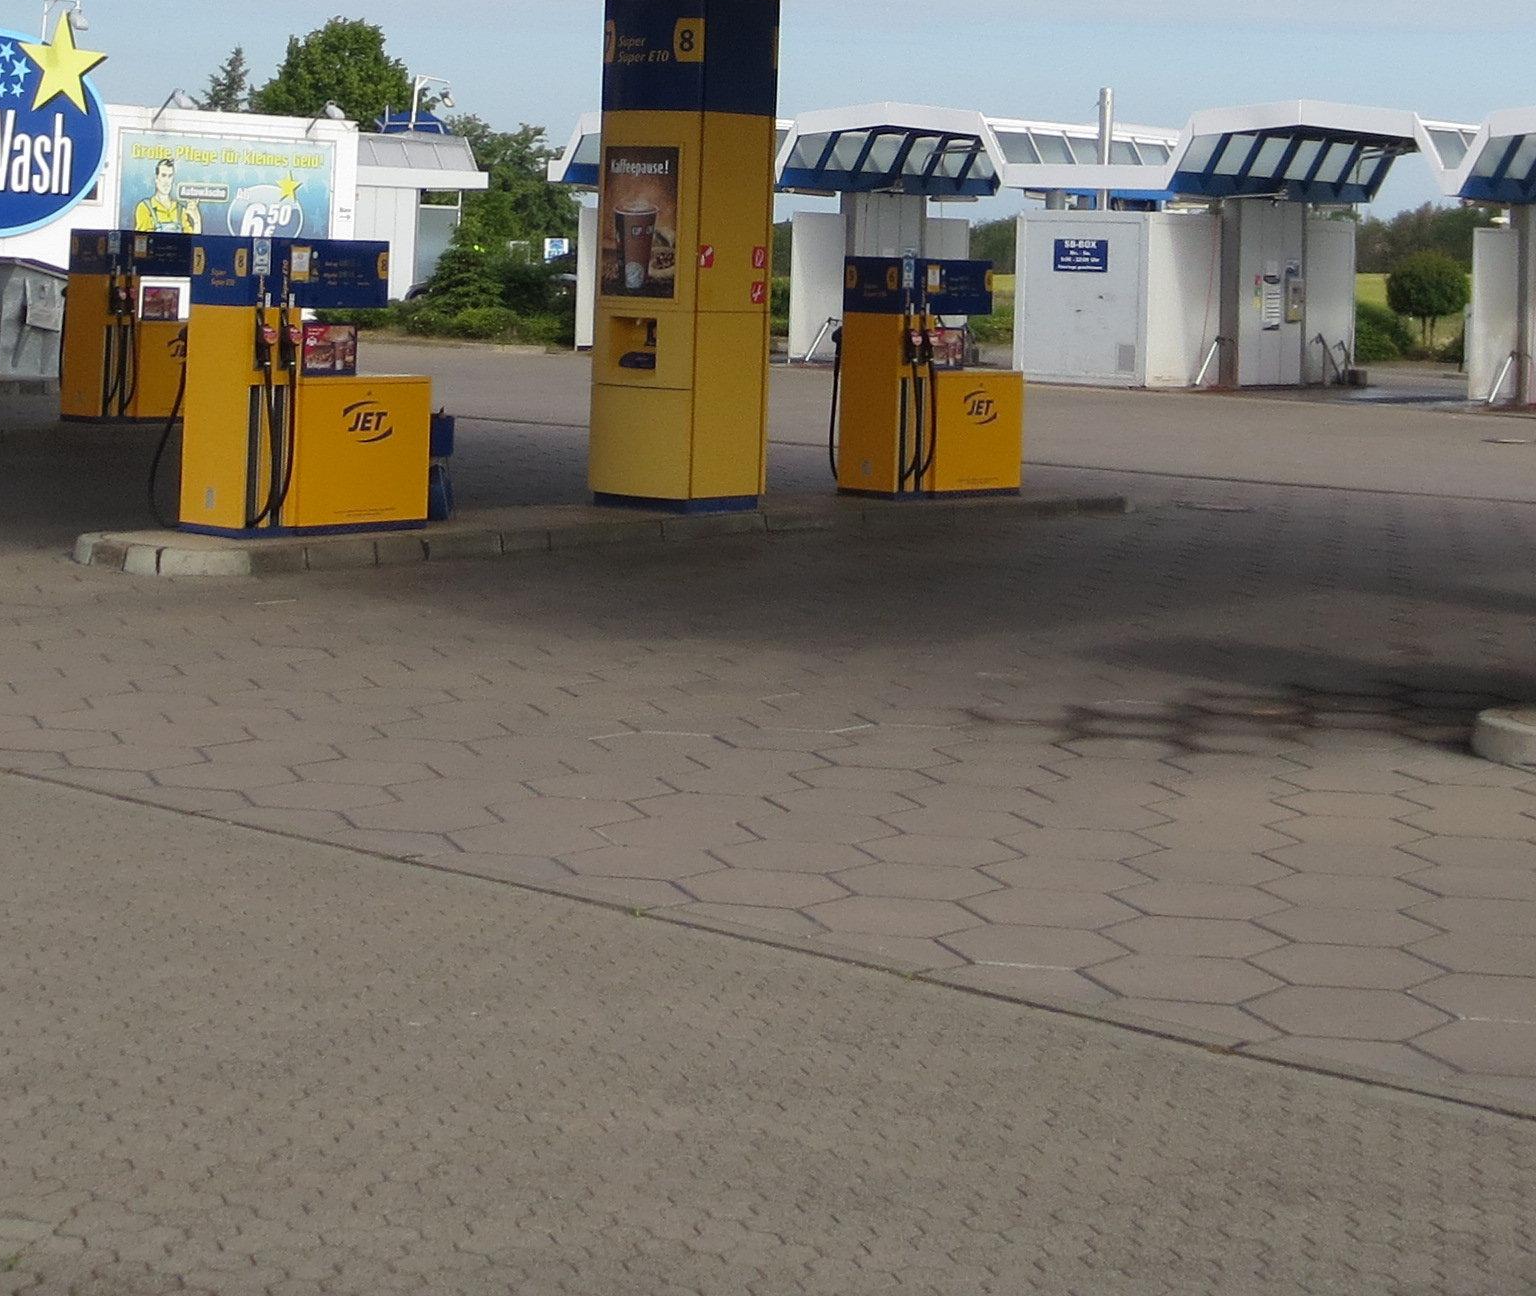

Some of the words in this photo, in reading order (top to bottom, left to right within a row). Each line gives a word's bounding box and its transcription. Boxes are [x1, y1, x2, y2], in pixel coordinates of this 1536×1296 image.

[618, 36, 645, 50] Super
[680, 30, 694, 52] 8
[617, 51, 646, 65] Super
[648, 50, 669, 62] E10
[175, 145, 216, 164] Pflege
[221, 149, 240, 165] für
[243, 152, 289, 168] kleines
[610, 159, 670, 177] Kaffeepause!
[967, 400, 994, 416] JET
[348, 412, 388, 432] JET
